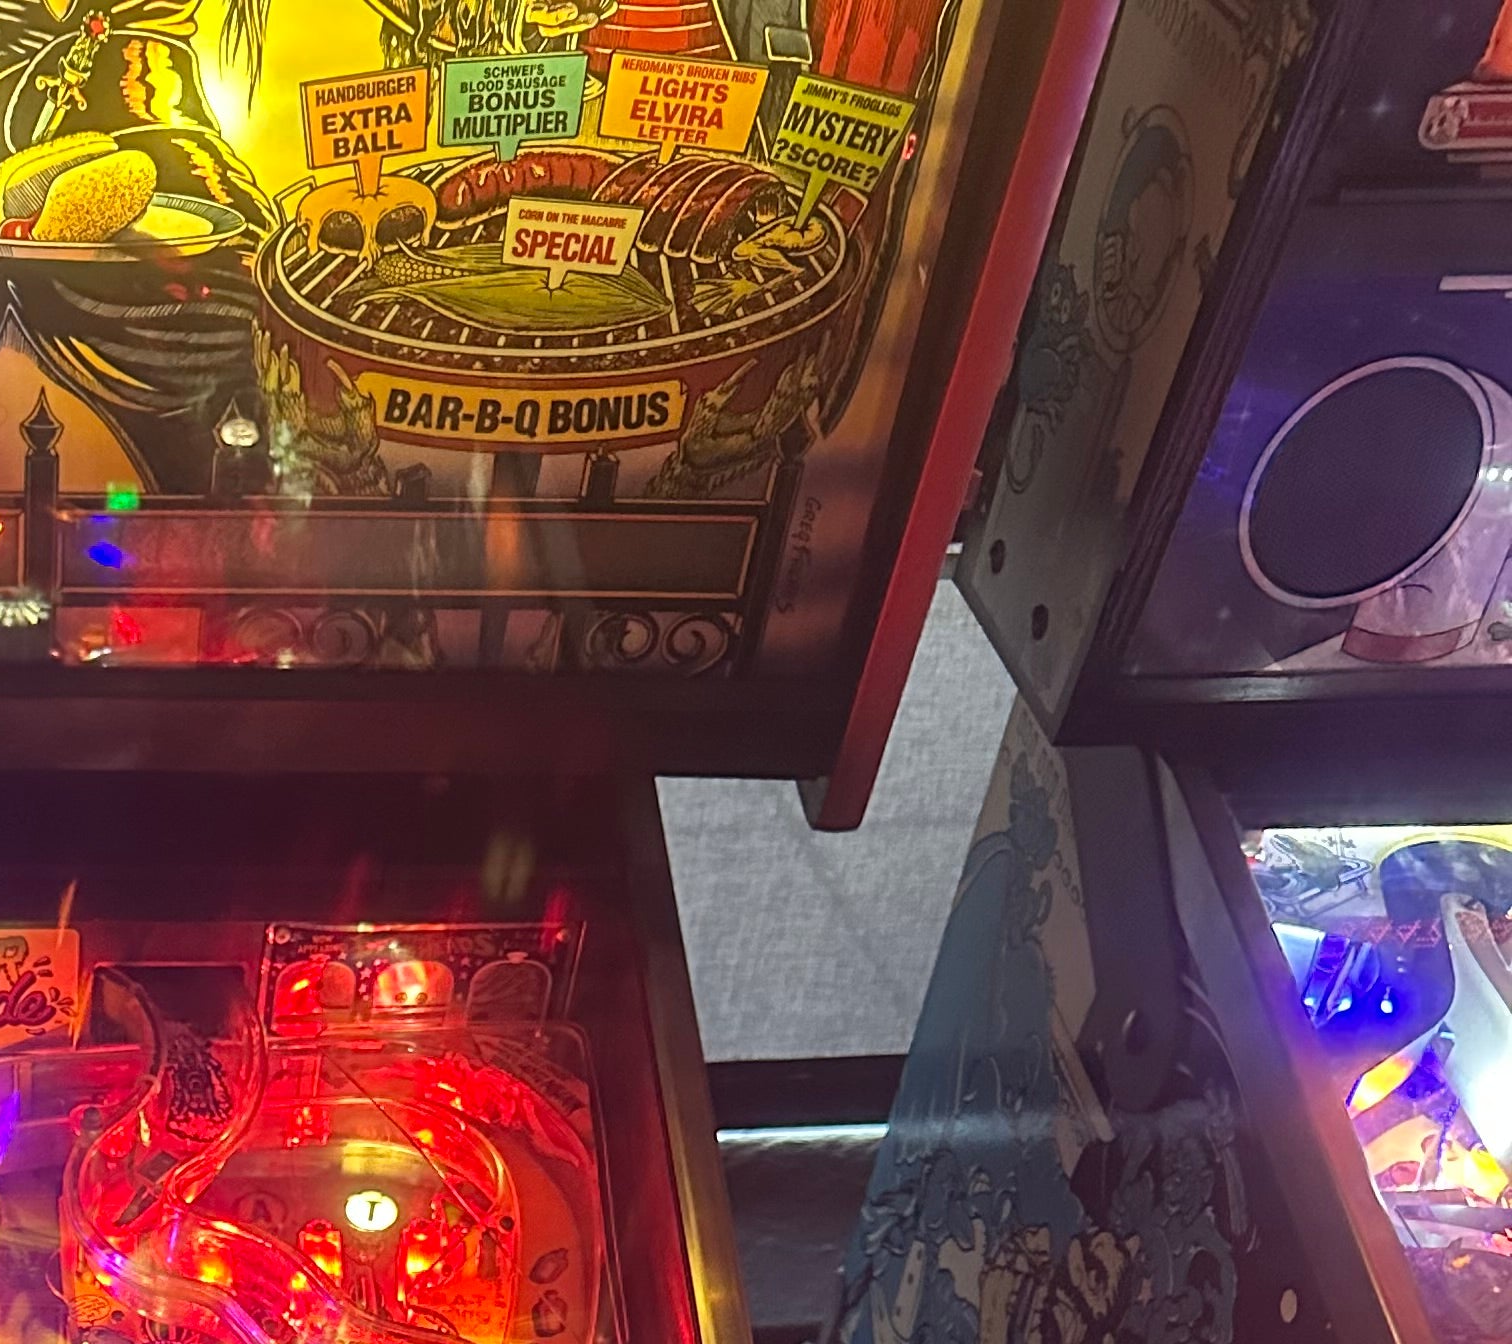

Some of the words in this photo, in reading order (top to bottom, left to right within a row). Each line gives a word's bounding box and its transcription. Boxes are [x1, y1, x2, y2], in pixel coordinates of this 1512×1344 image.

[460, 80, 504, 94] BLOOD
[506, 75, 567, 90] SAUSAGE
[483, 63, 545, 80] SCHWEI'S
[621, 57, 684, 77] NERDMAN'S
[687, 62, 731, 82] BROKEN
[732, 69, 757, 85] RIBS
[315, 75, 417, 108] HANDBURGER
[468, 88, 556, 114] BONUS
[639, 75, 729, 104] LIGHTS
[801, 83, 847, 105] JIMMY'S
[321, 101, 413, 135] EXTRA
[452, 109, 569, 140] MULTIPLIER
[630, 100, 724, 130] ELVIRA
[783, 101, 898, 158] MYSTERY
[333, 130, 403, 159] BALL
[638, 124, 708, 145] LETTER
[518, 208, 543, 222] CORN
[545, 211, 560, 223] ON
[560, 212, 579, 225] THE
[580, 214, 627, 230] MACABRE
[512, 227, 618, 266] SPECIAL
[384, 387, 541, 438] BAR-B-Q
[547, 389, 670, 436] BONUS
